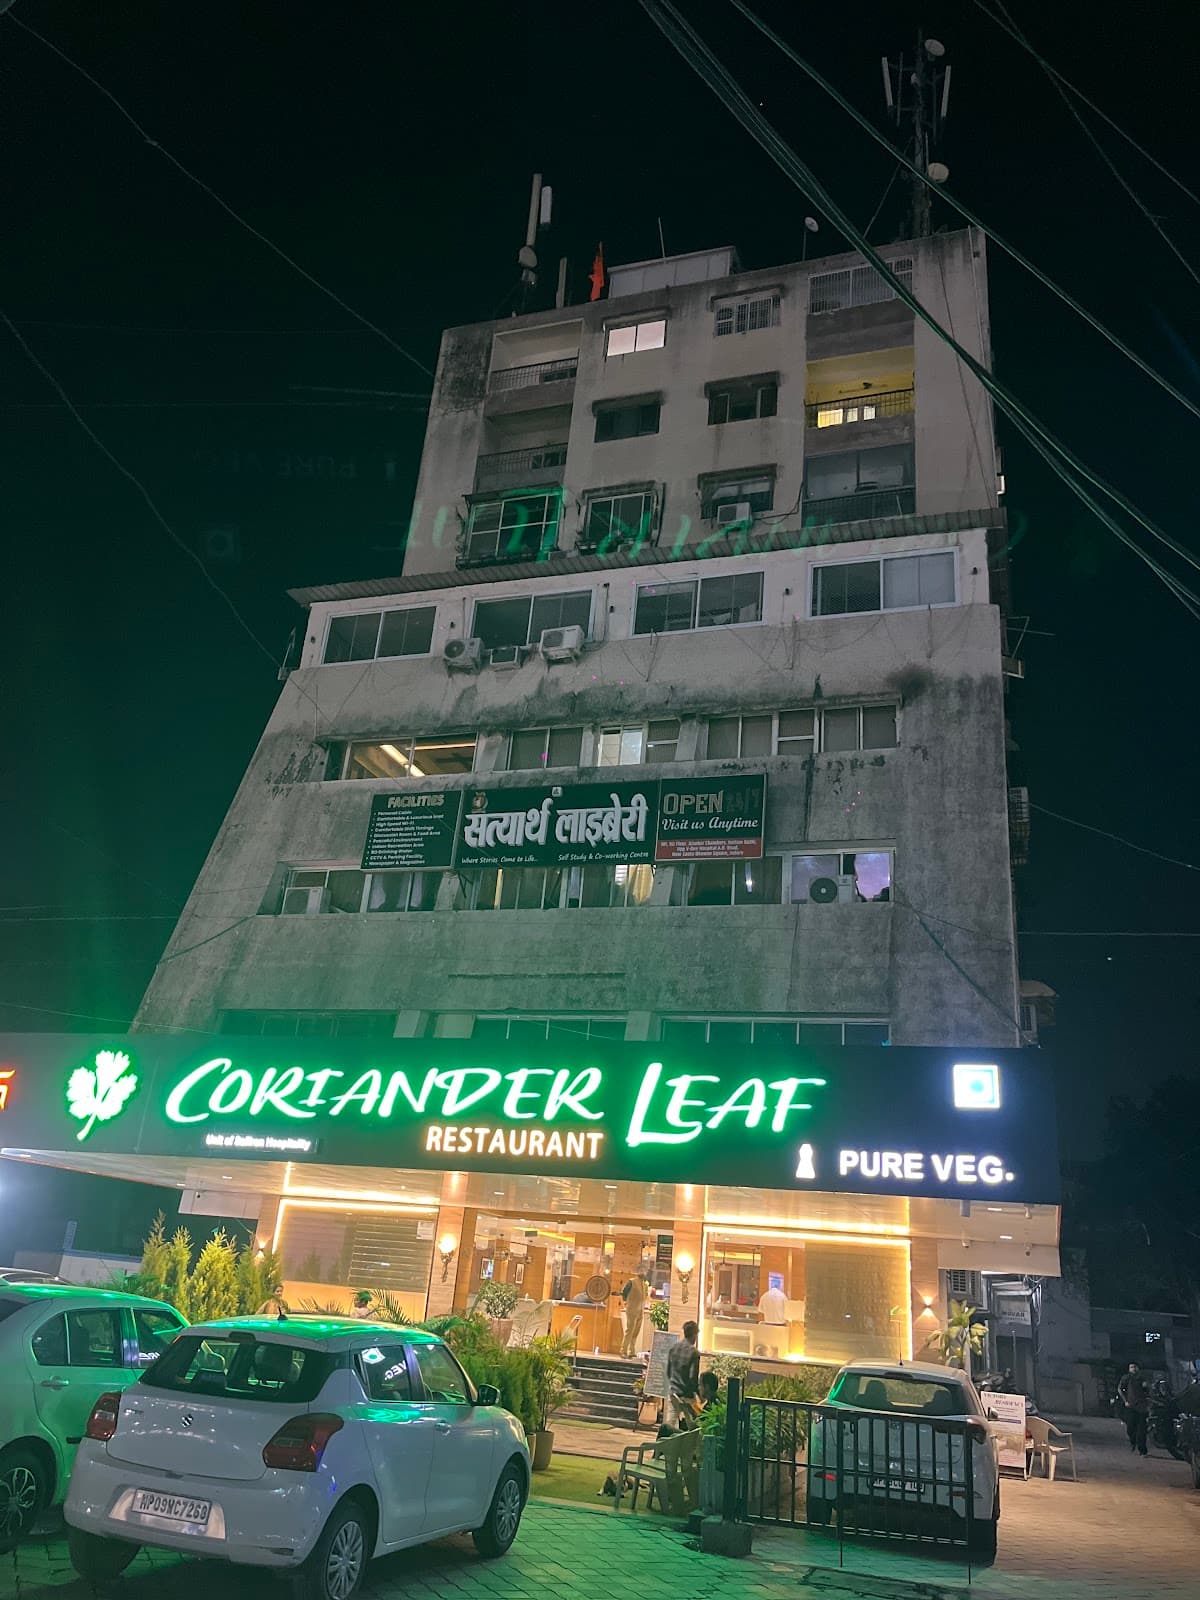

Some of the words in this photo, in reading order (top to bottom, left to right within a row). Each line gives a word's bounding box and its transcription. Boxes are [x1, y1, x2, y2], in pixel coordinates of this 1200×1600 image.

[387, 795, 445, 808] FACILITIES
[663, 790, 723, 815] OPEN
[465, 797, 553, 848] सत्यार्थ
[555, 793, 649, 848] लाइब्रेरी
[662, 818, 689, 831] Visit
[691, 821, 705, 830] us
[709, 816, 759, 832] Anytime
[480, 856, 498, 864] Stories
[558, 853, 569, 861] Self
[570, 853, 586, 862] Study
[588, 852, 594, 860] &
[595, 851, 628, 860] Co-working
[165, 1057, 604, 1124] CORIANDER
[625, 1062, 827, 1147] LEAF
[425, 1125, 604, 1159] RESTAURANT
[839, 1150, 924, 1179] PURE
[931, 1154, 1014, 1184] VEG.
